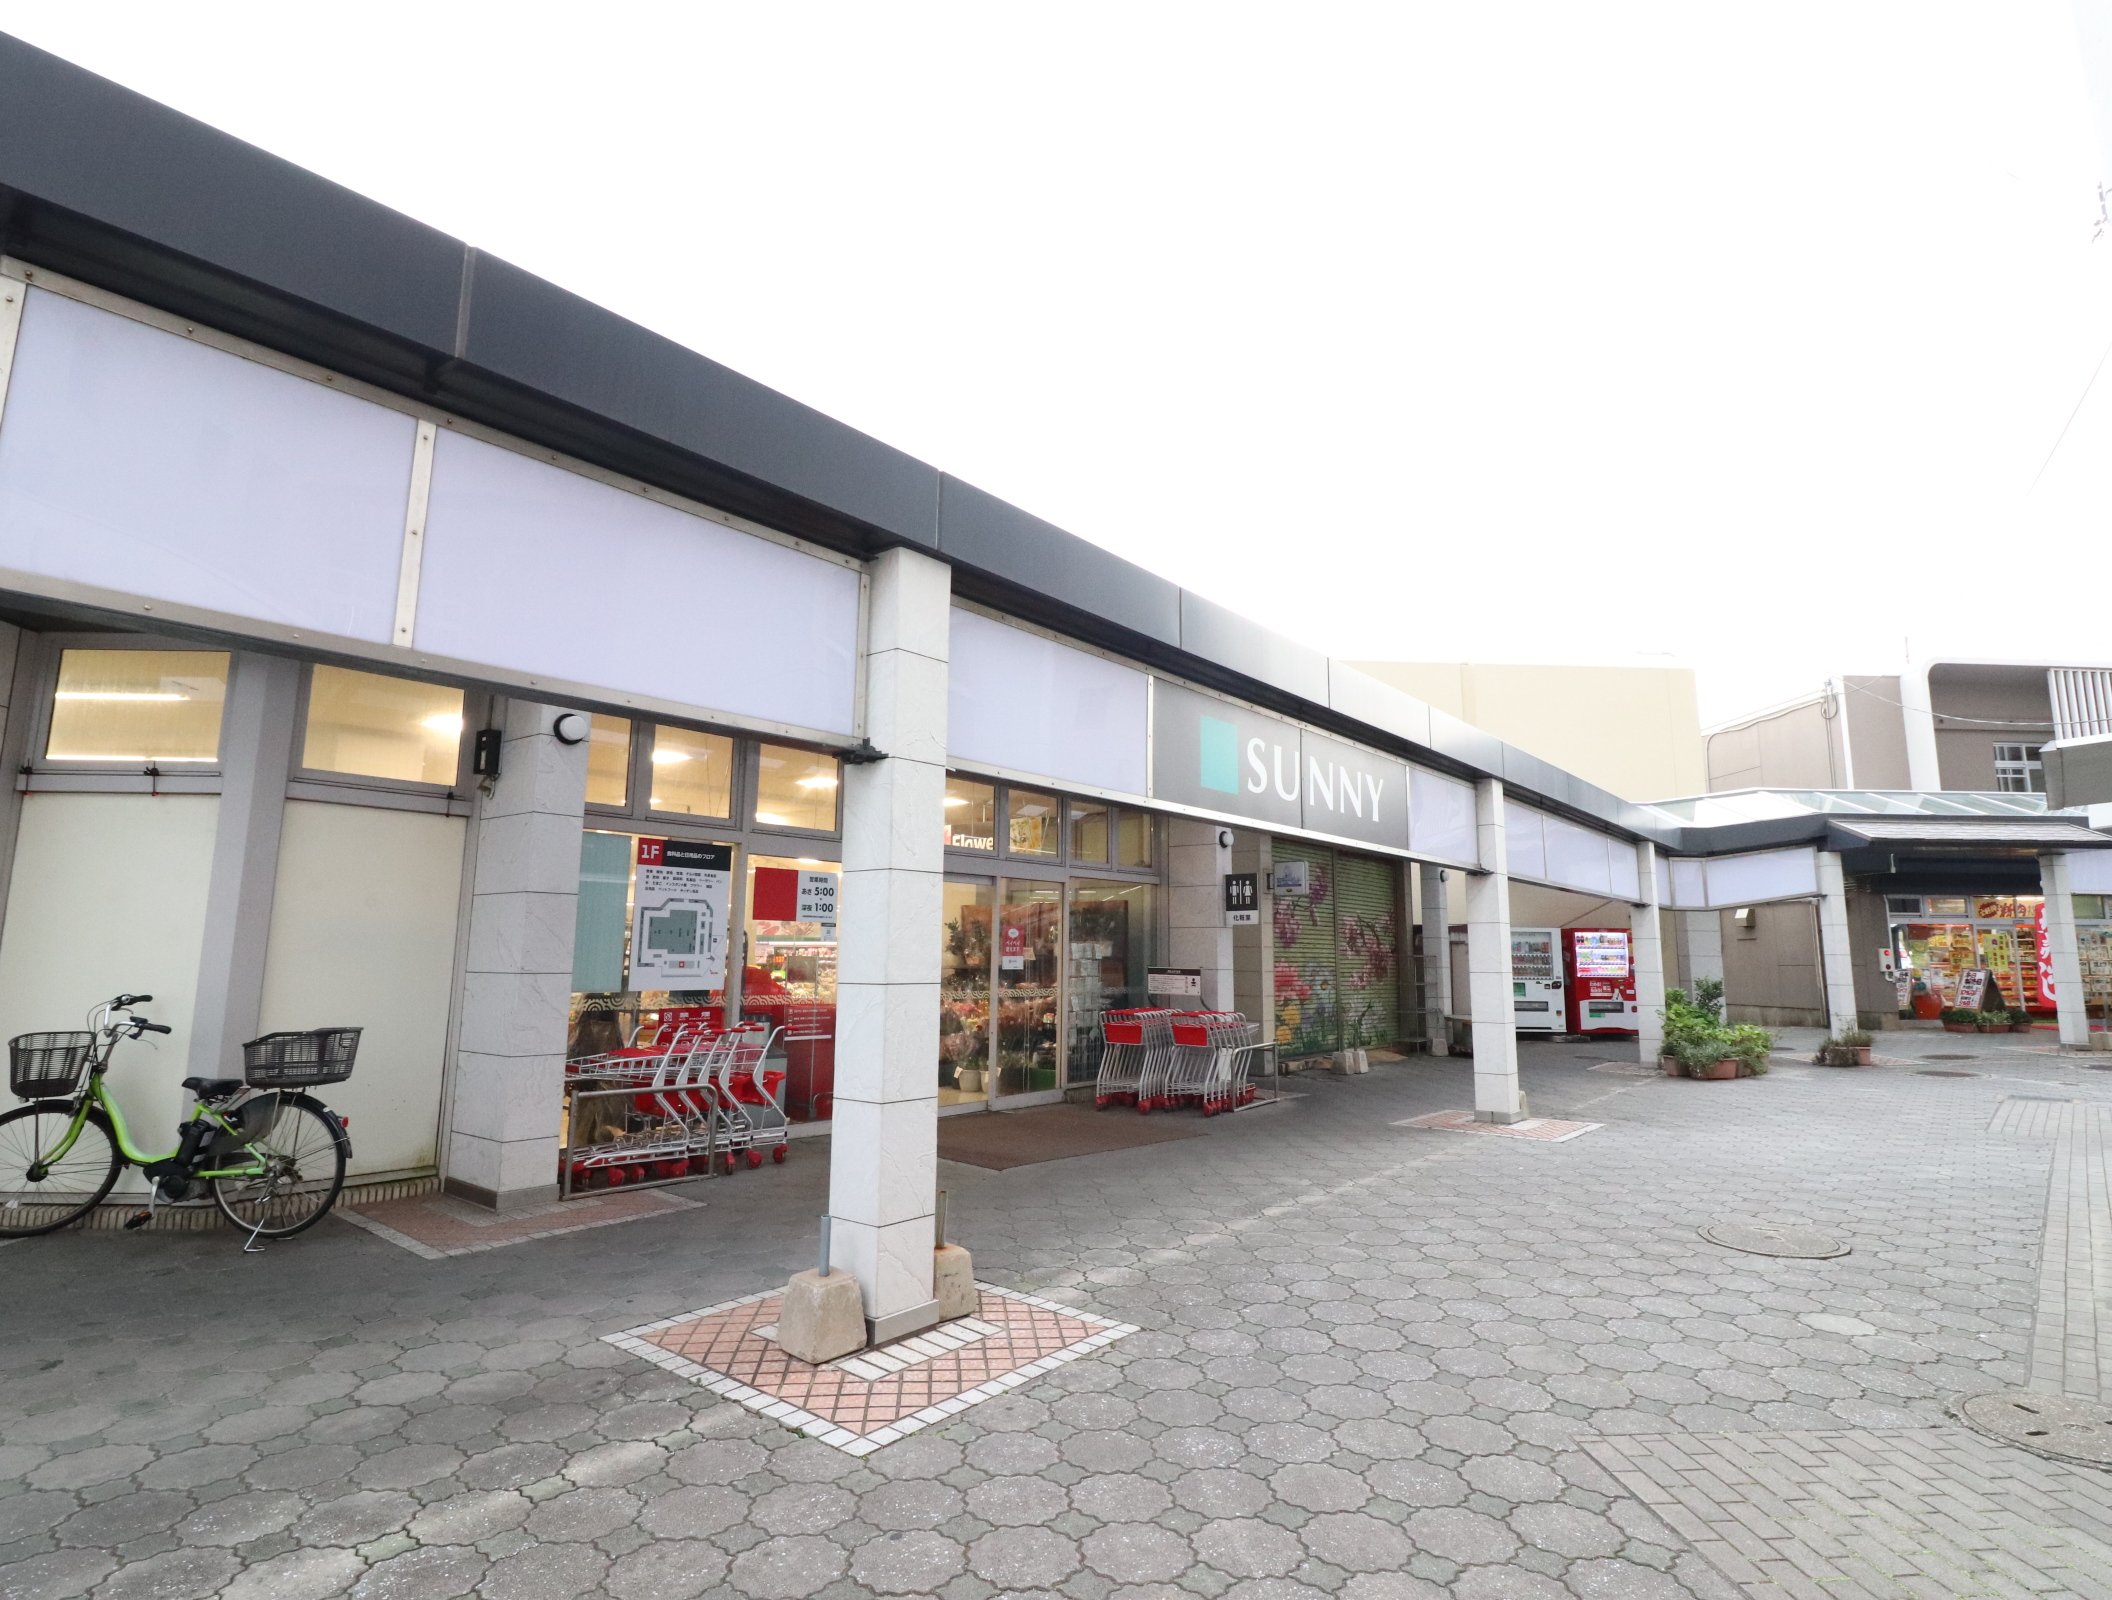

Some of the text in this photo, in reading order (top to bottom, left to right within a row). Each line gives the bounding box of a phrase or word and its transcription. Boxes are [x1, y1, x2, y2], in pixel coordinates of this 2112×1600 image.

[1247, 737, 1384, 823] SUNNY
[641, 844, 660, 859] 1F
[814, 886, 835, 897] 5:00
[814, 902, 834, 913] 1:00
[1233, 914, 1251, 922] 化粧室
